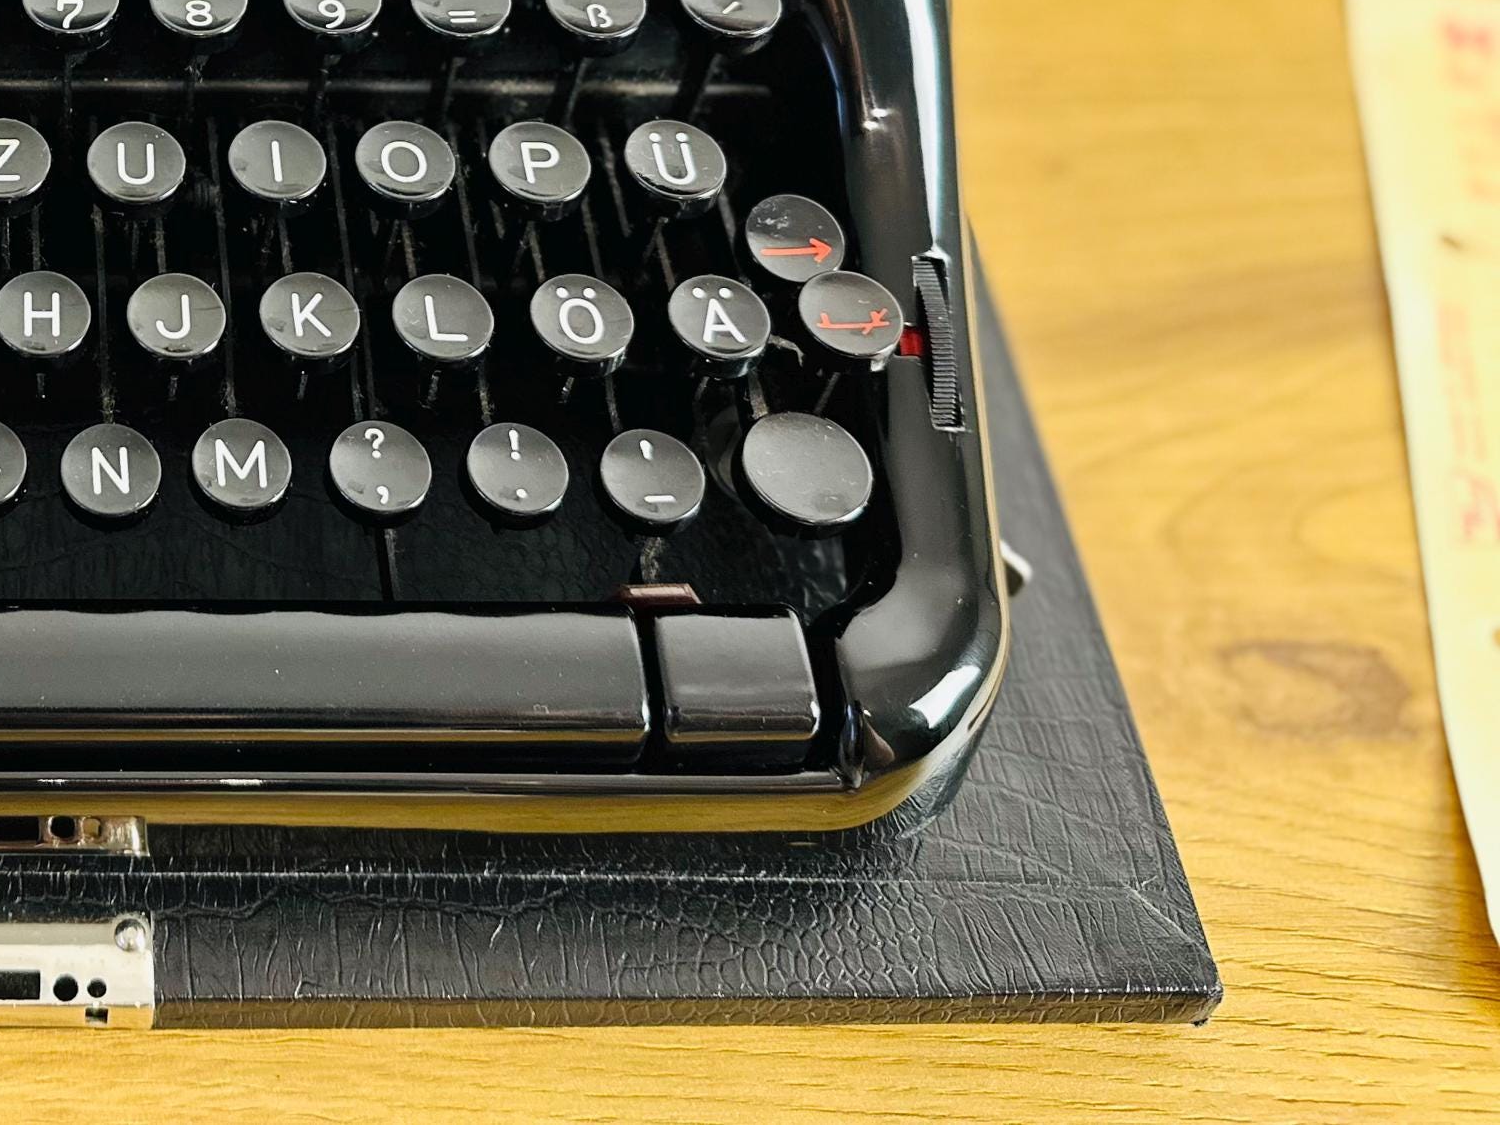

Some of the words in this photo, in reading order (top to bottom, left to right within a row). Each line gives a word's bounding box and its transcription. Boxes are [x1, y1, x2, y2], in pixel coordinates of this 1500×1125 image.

[185, 0, 213, 27] 8
[447, 10, 478, 23] =
[117, 142, 155, 185] U
[271, 140, 283, 183] I
[380, 141, 427, 183] O
[520, 141, 560, 184] P
[648, 132, 697, 185] Ü
[23, 291, 61, 337] H
[155, 294, 191, 340] J
[291, 292, 332, 337] K
[424, 295, 469, 342] L
[556, 287, 604, 345] Ö
[692, 287, 747, 344] Ä
[91, 446, 130, 495] N
[214, 438, 268, 489] M
[364, 428, 385, 459] ?
[508, 429, 521, 461] !
